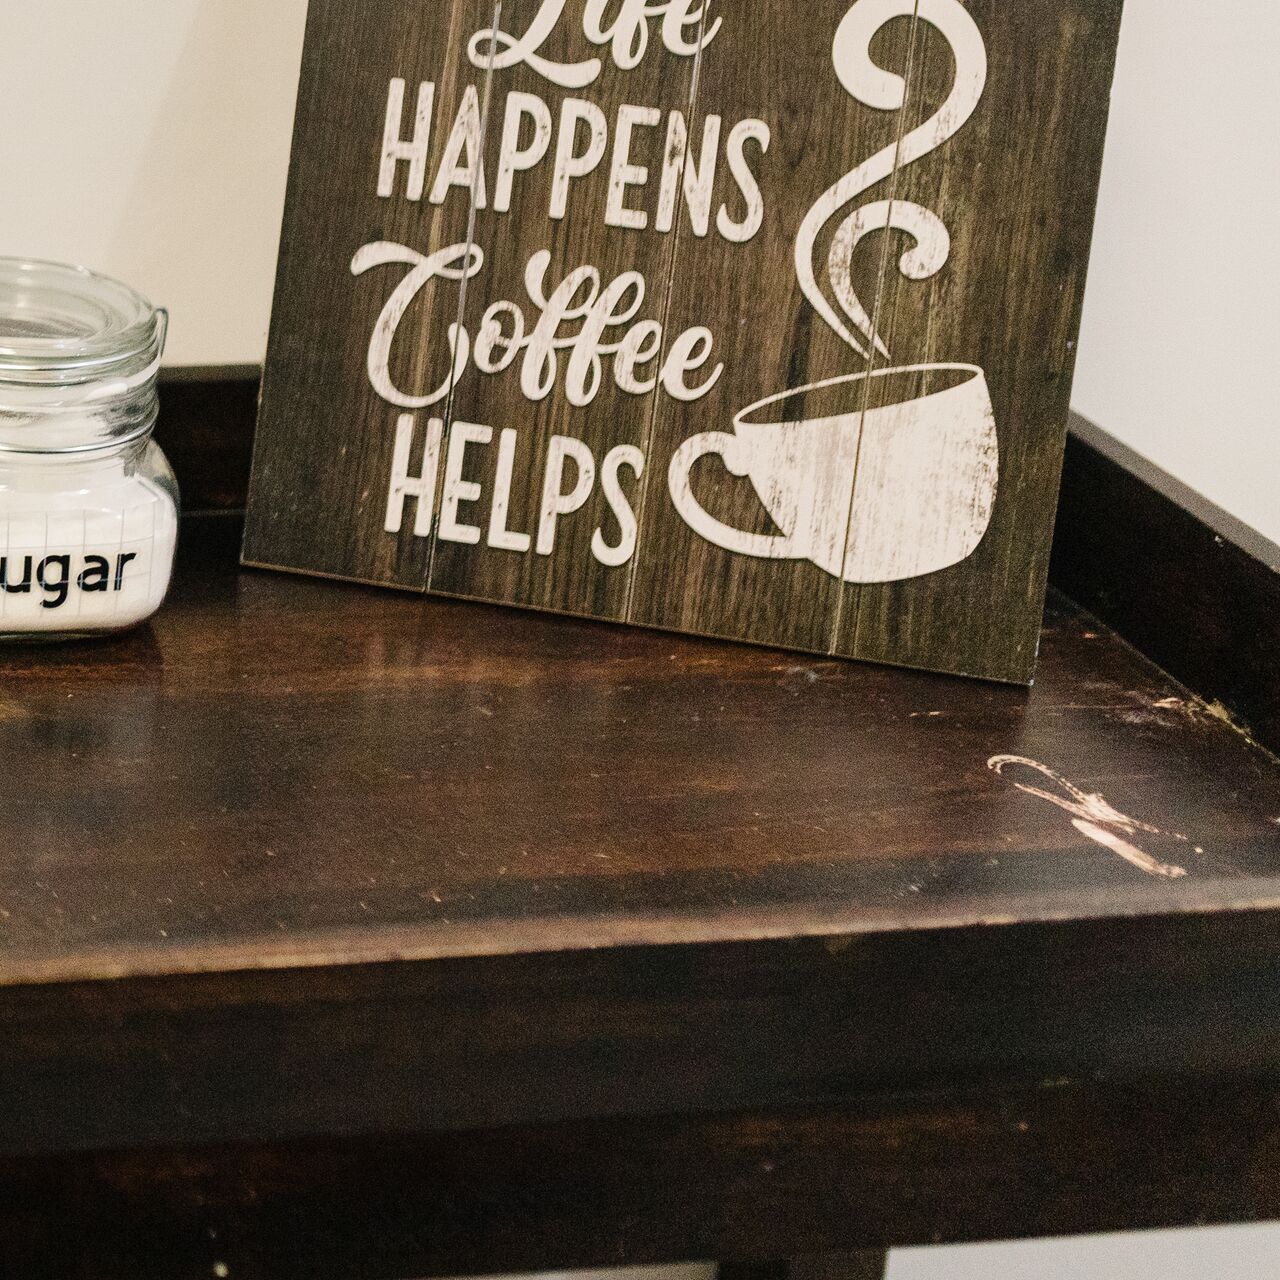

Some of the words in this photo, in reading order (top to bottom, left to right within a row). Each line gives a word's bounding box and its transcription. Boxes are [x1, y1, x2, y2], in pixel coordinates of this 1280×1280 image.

[377, 78, 771, 242] HAPPENS
[351, 241, 724, 408] Coffee
[384, 415, 645, 567] HELPS
